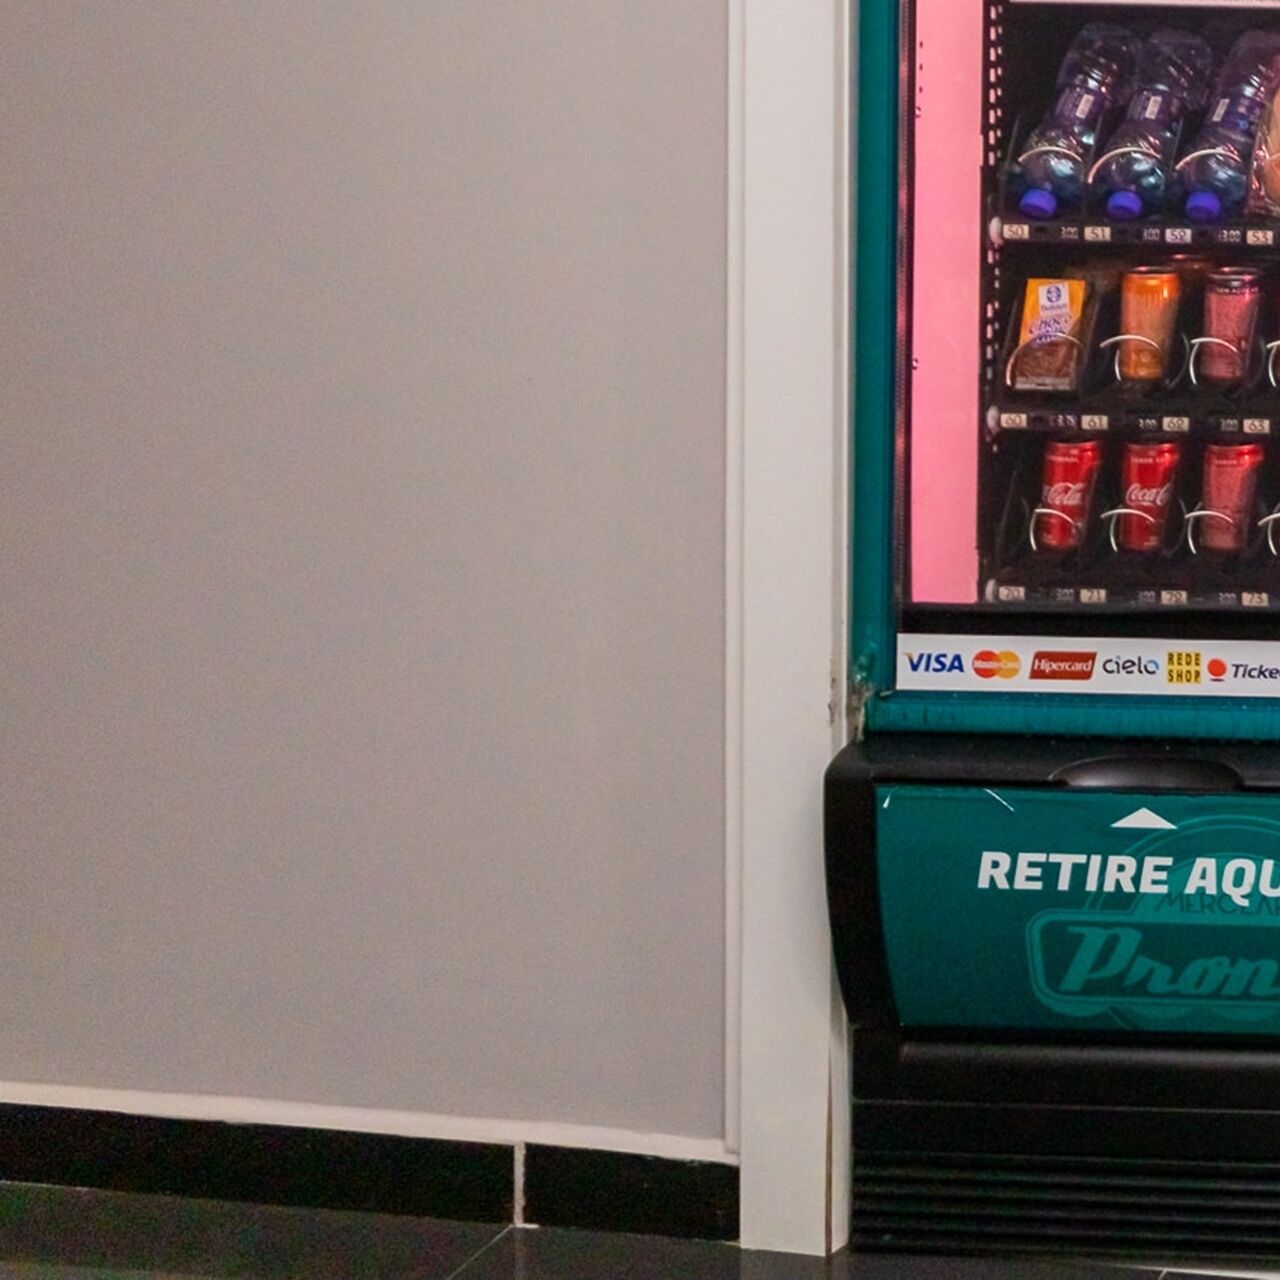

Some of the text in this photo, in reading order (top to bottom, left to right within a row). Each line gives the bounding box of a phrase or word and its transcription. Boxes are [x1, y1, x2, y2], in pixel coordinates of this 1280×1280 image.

[904, 652, 965, 673] VISA
[1033, 657, 1093, 673] Hipercard
[1102, 655, 1160, 675] cielo
[1167, 652, 1201, 666] REDE
[1167, 669, 1201, 683] SHOP
[977, 850, 1174, 894] RETIRE
